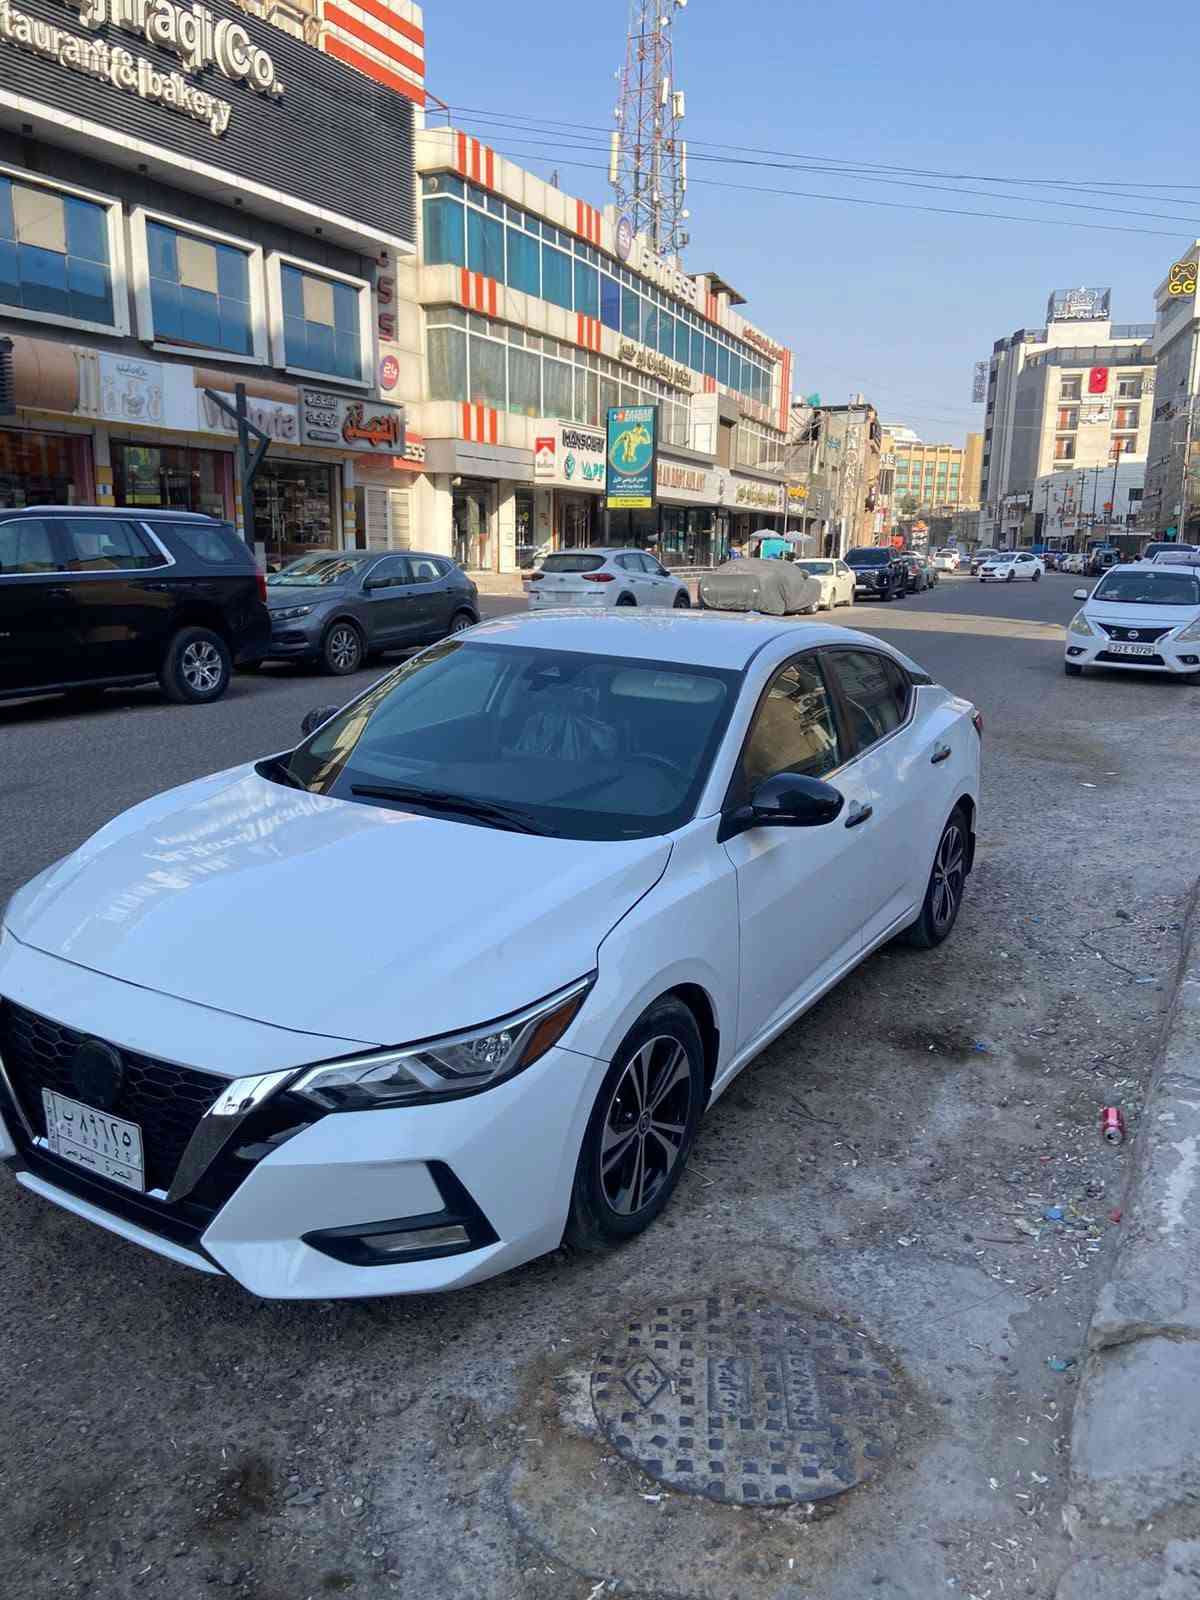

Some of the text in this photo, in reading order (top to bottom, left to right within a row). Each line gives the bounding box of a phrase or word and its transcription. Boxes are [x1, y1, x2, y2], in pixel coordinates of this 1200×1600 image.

[137, 57, 232, 136] bakery
[1169, 280, 1196, 294] GG
[383, 362, 398, 376] 24
